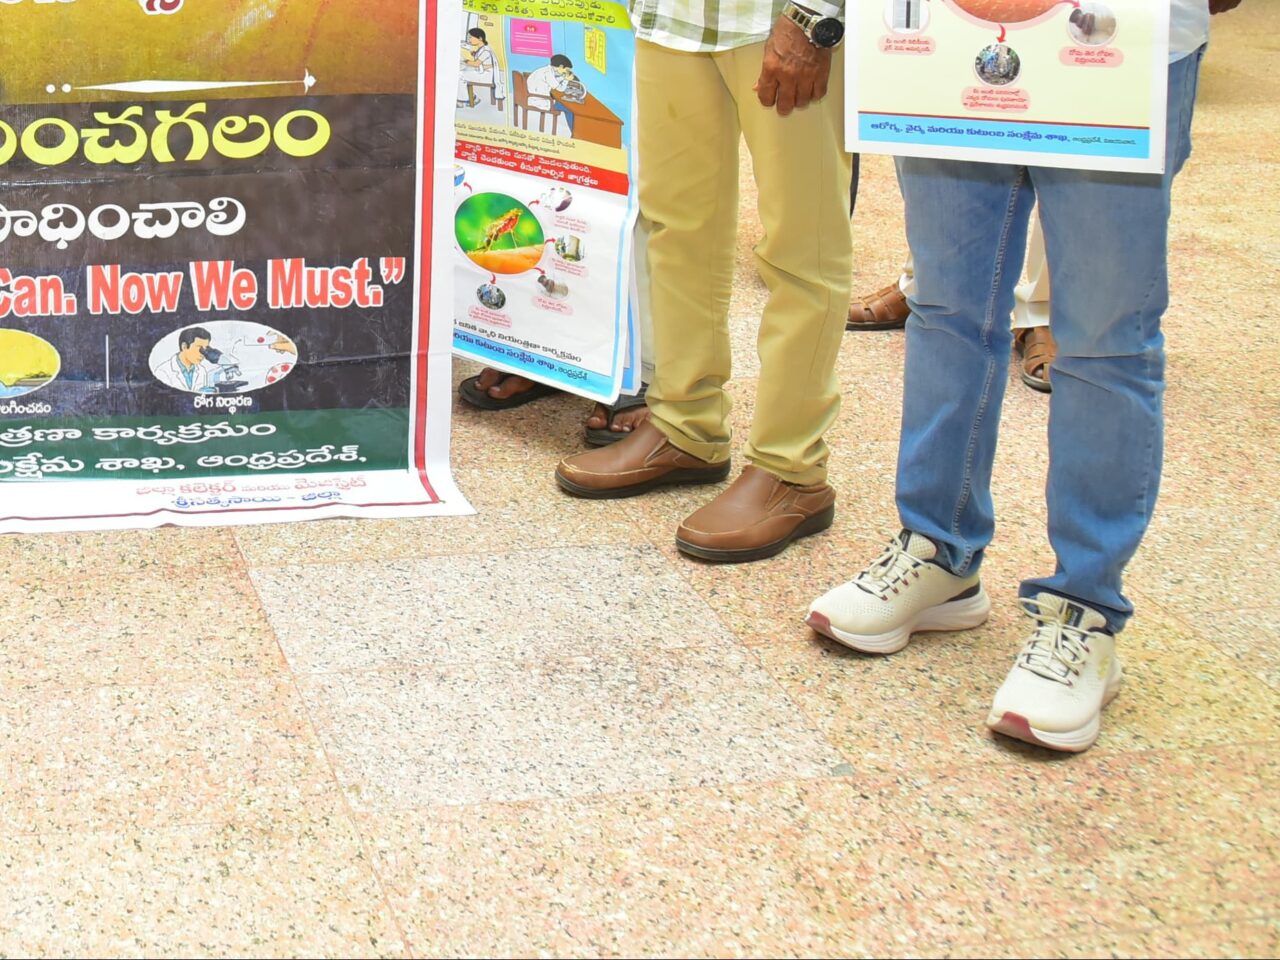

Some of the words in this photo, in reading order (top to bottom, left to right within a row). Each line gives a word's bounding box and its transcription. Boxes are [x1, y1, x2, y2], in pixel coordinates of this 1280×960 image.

[927, 125, 964, 135] మరియు
[967, 128, 1004, 138] కుటుంబ
[87, 263, 182, 314] Now
[190, 259, 256, 311] We
[194, 394, 214, 408] రోగ
[92, 420, 276, 446] కార్యక్రమం
[95, 455, 185, 474] శాఖ,
